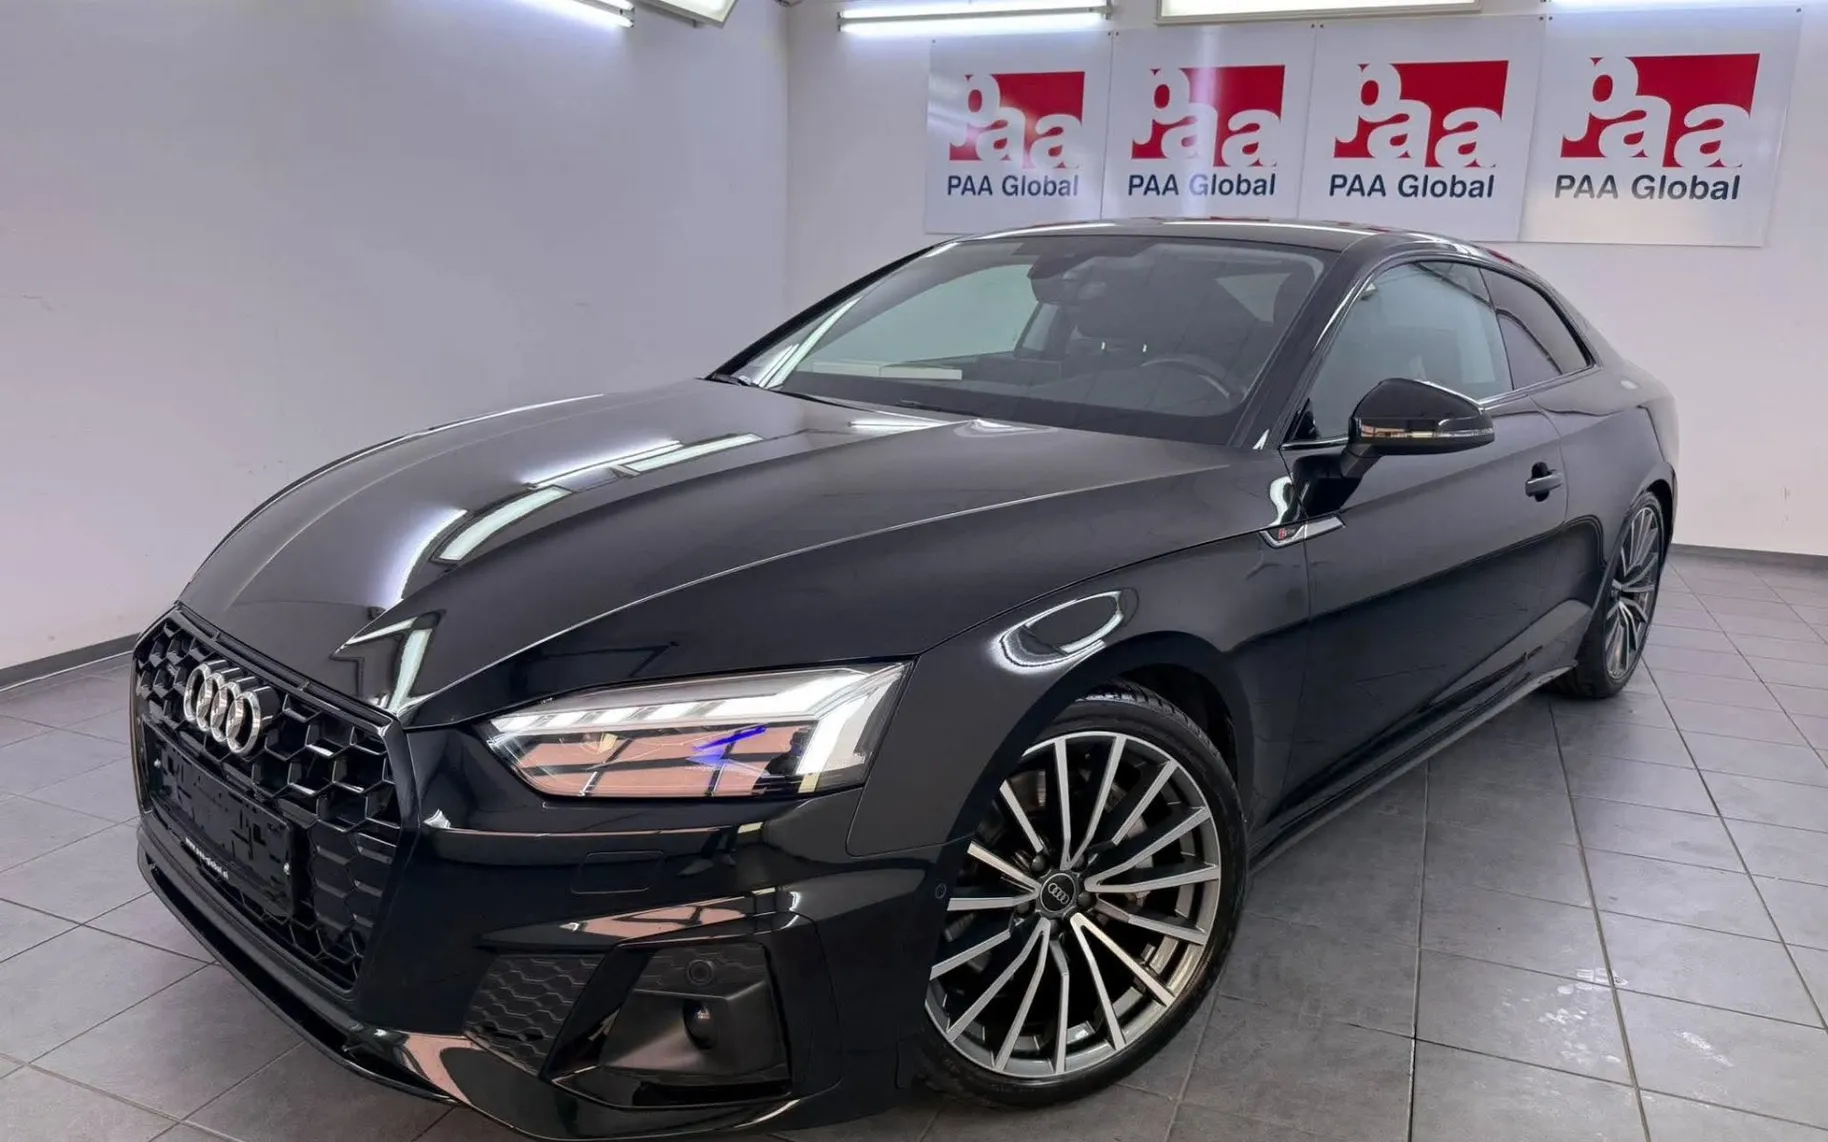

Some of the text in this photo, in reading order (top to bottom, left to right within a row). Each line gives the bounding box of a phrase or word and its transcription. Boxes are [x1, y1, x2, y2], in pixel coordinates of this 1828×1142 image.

[947, 174, 1079, 197] PAA Global
[1128, 173, 1276, 196] PAA Global
[1329, 174, 1495, 198] PAA Global
[1554, 174, 1740, 200] PAA Global
